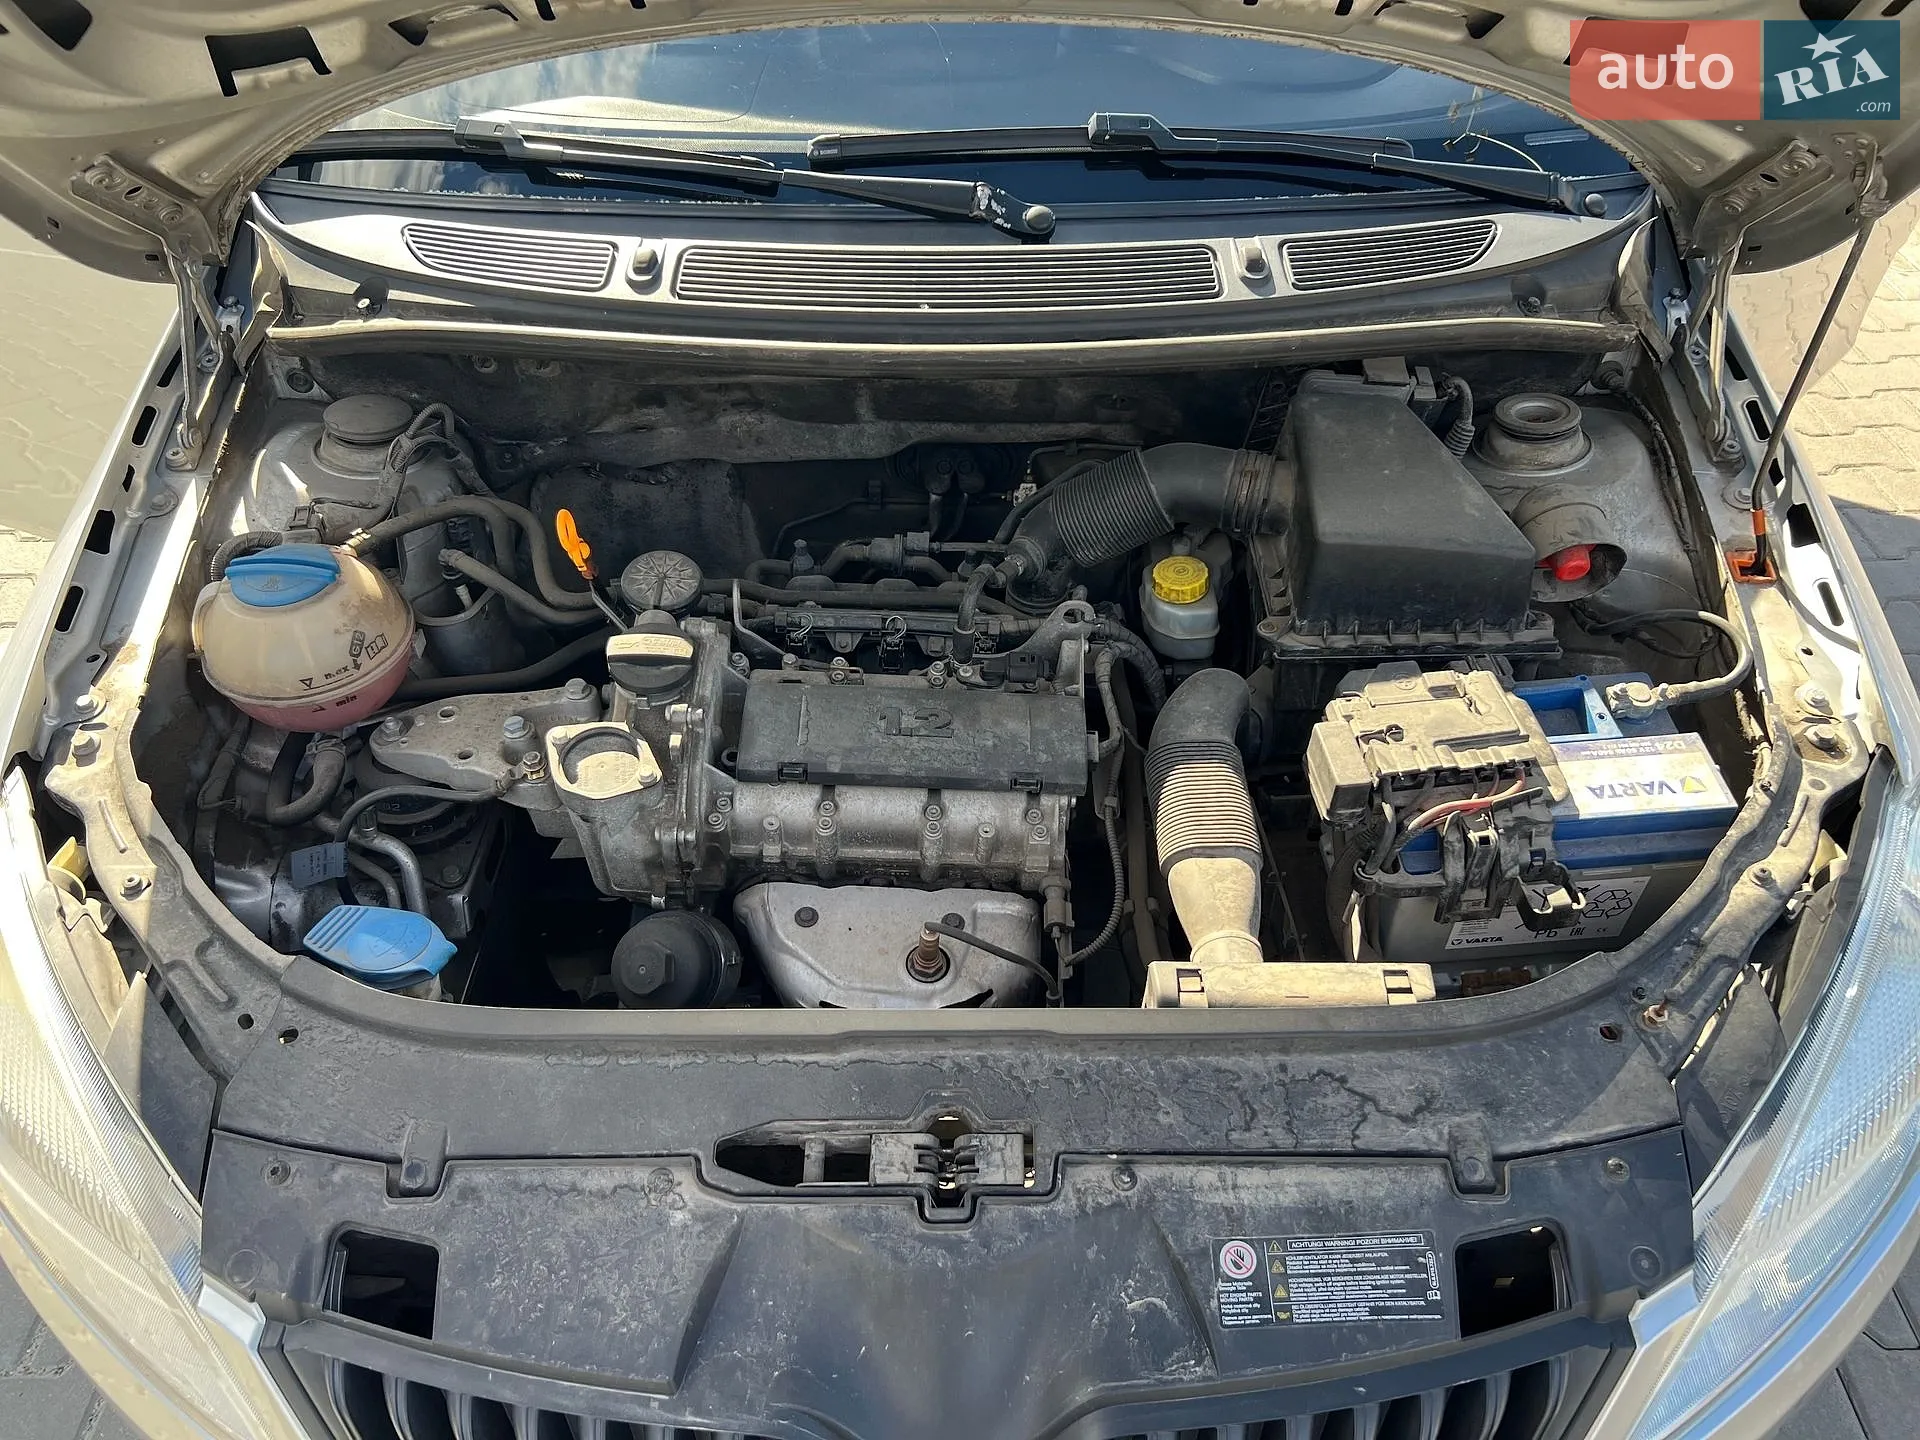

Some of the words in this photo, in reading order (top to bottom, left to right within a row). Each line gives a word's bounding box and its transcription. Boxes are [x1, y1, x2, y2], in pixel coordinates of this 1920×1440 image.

[324, 665, 350, 680] max
[335, 694, 357, 707] min
[1586, 779, 1677, 799] VARTA
[1466, 936, 1504, 944] VARTA
